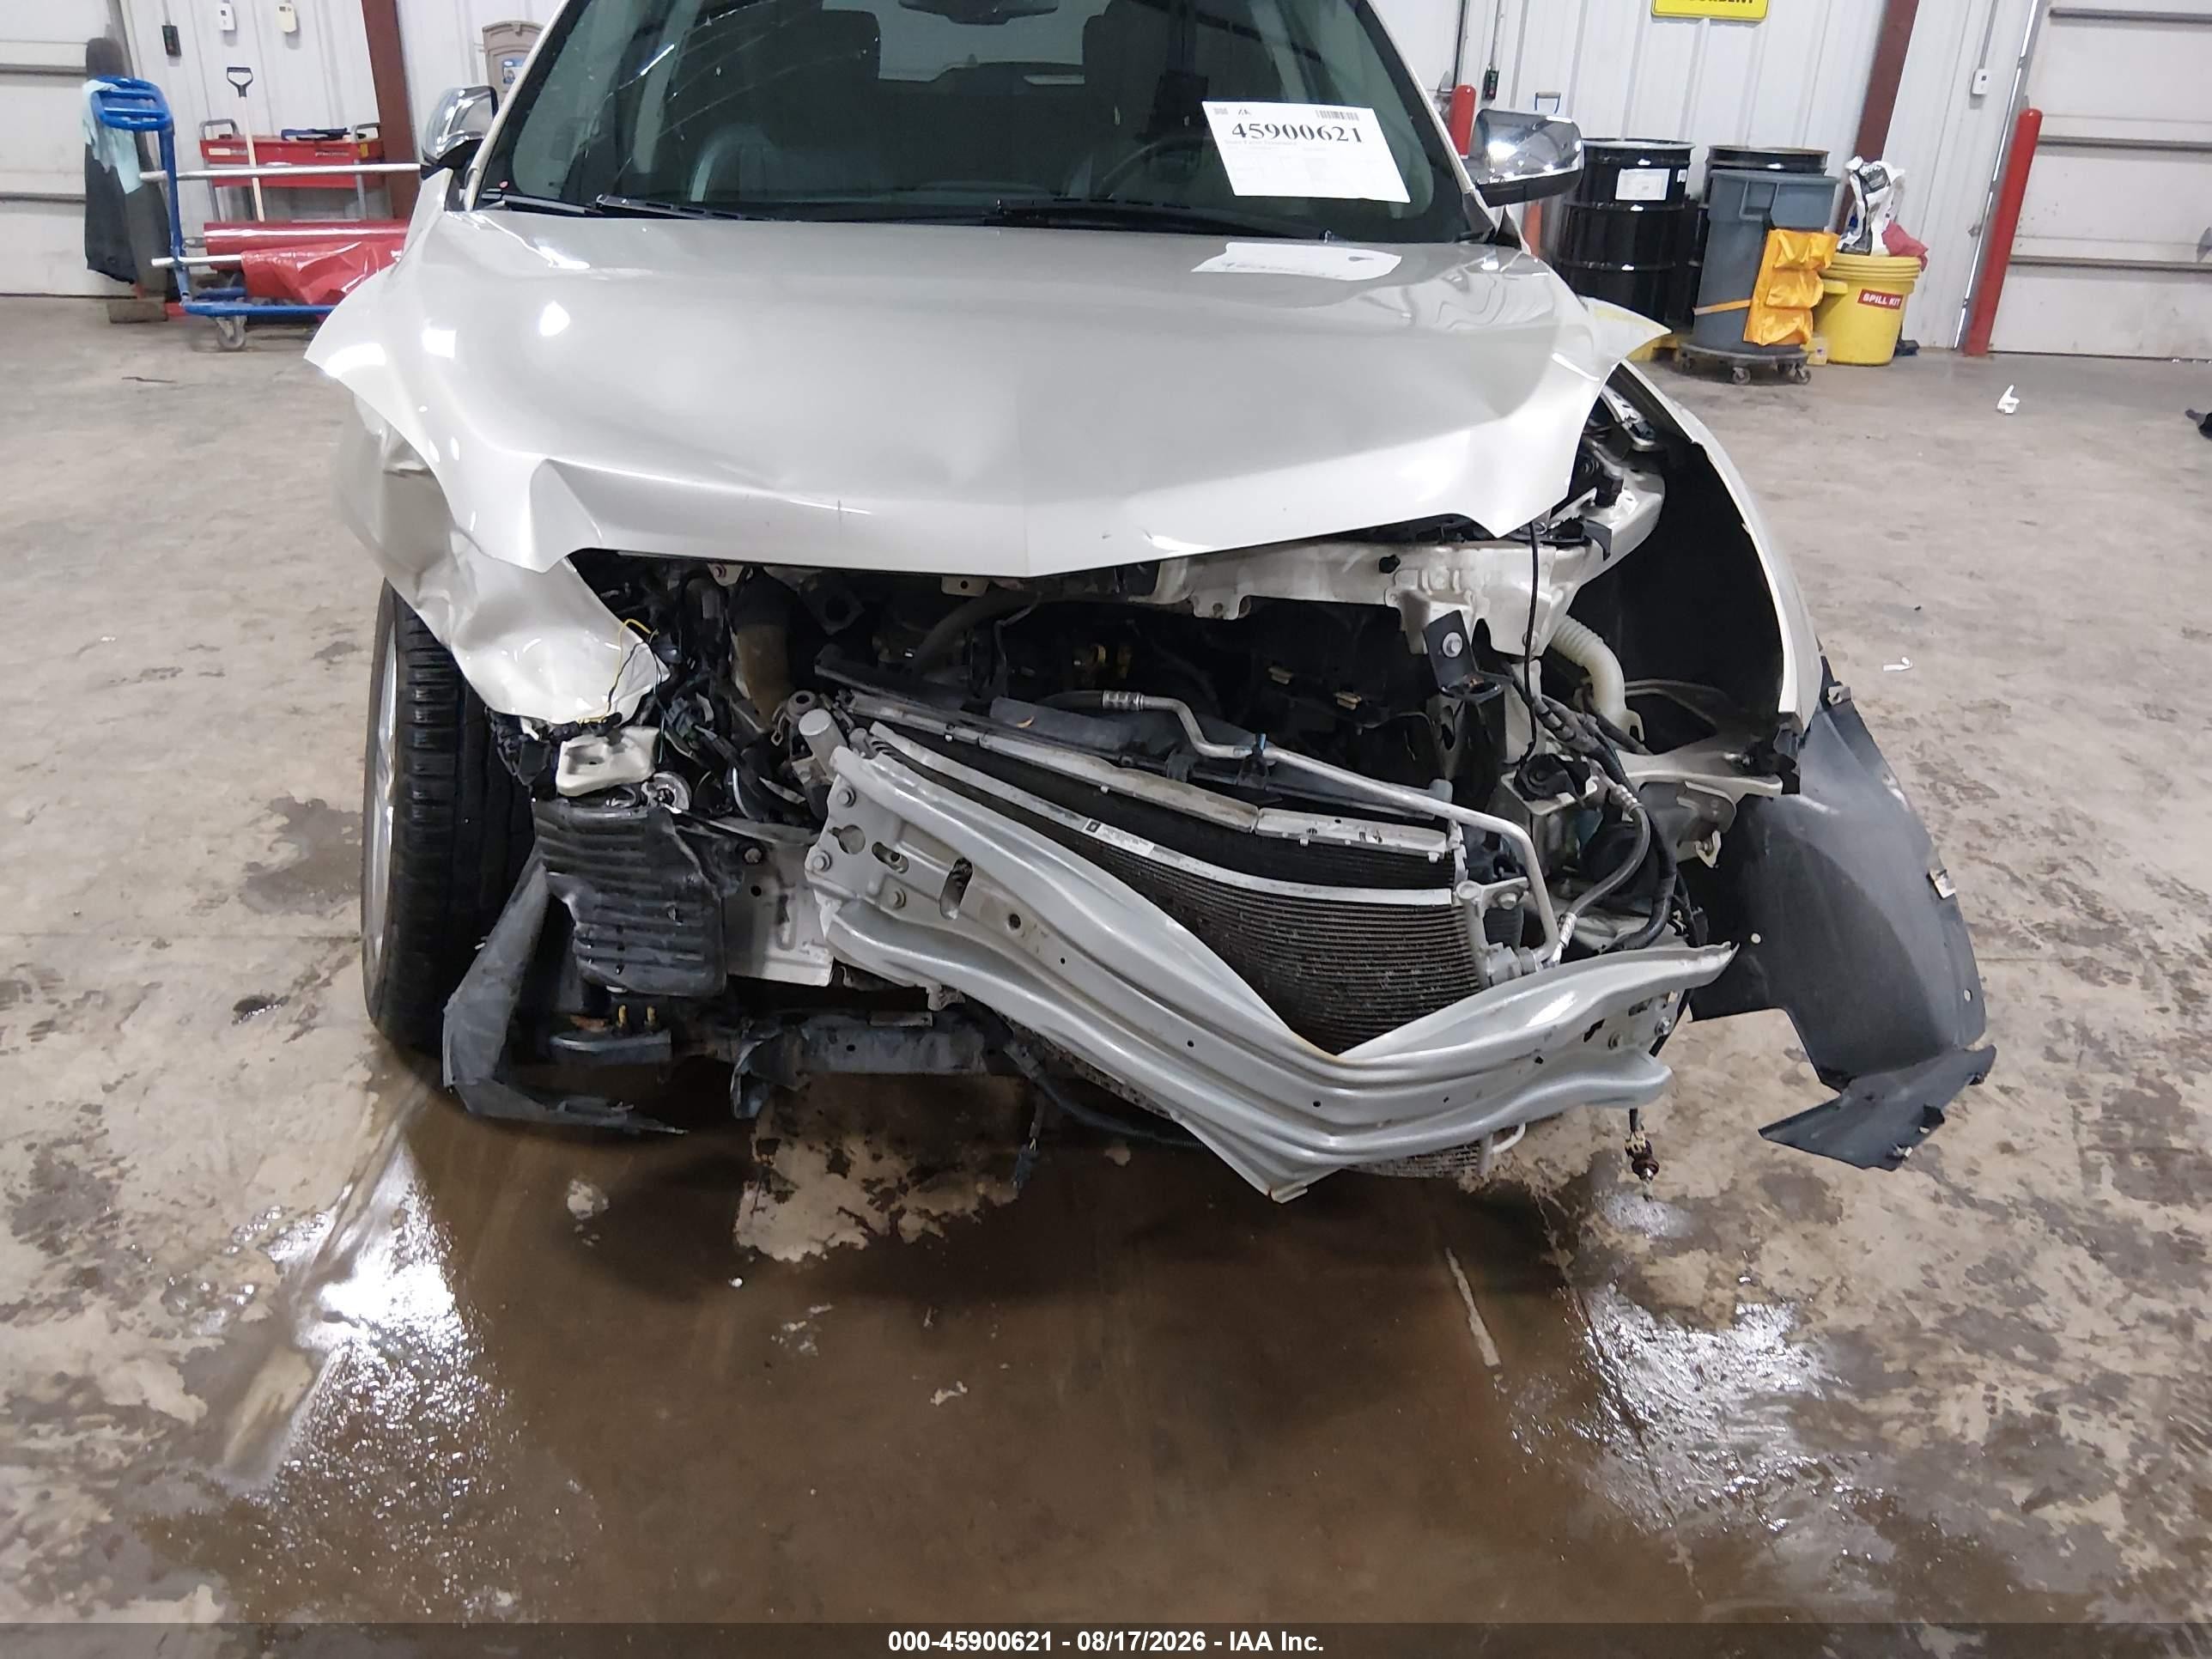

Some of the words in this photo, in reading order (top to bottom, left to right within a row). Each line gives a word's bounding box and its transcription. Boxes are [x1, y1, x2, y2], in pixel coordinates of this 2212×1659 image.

[1231, 122, 1363, 143] 45900621
[1863, 293, 1887, 305] SPILL
[1888, 297, 1901, 307] KIT
